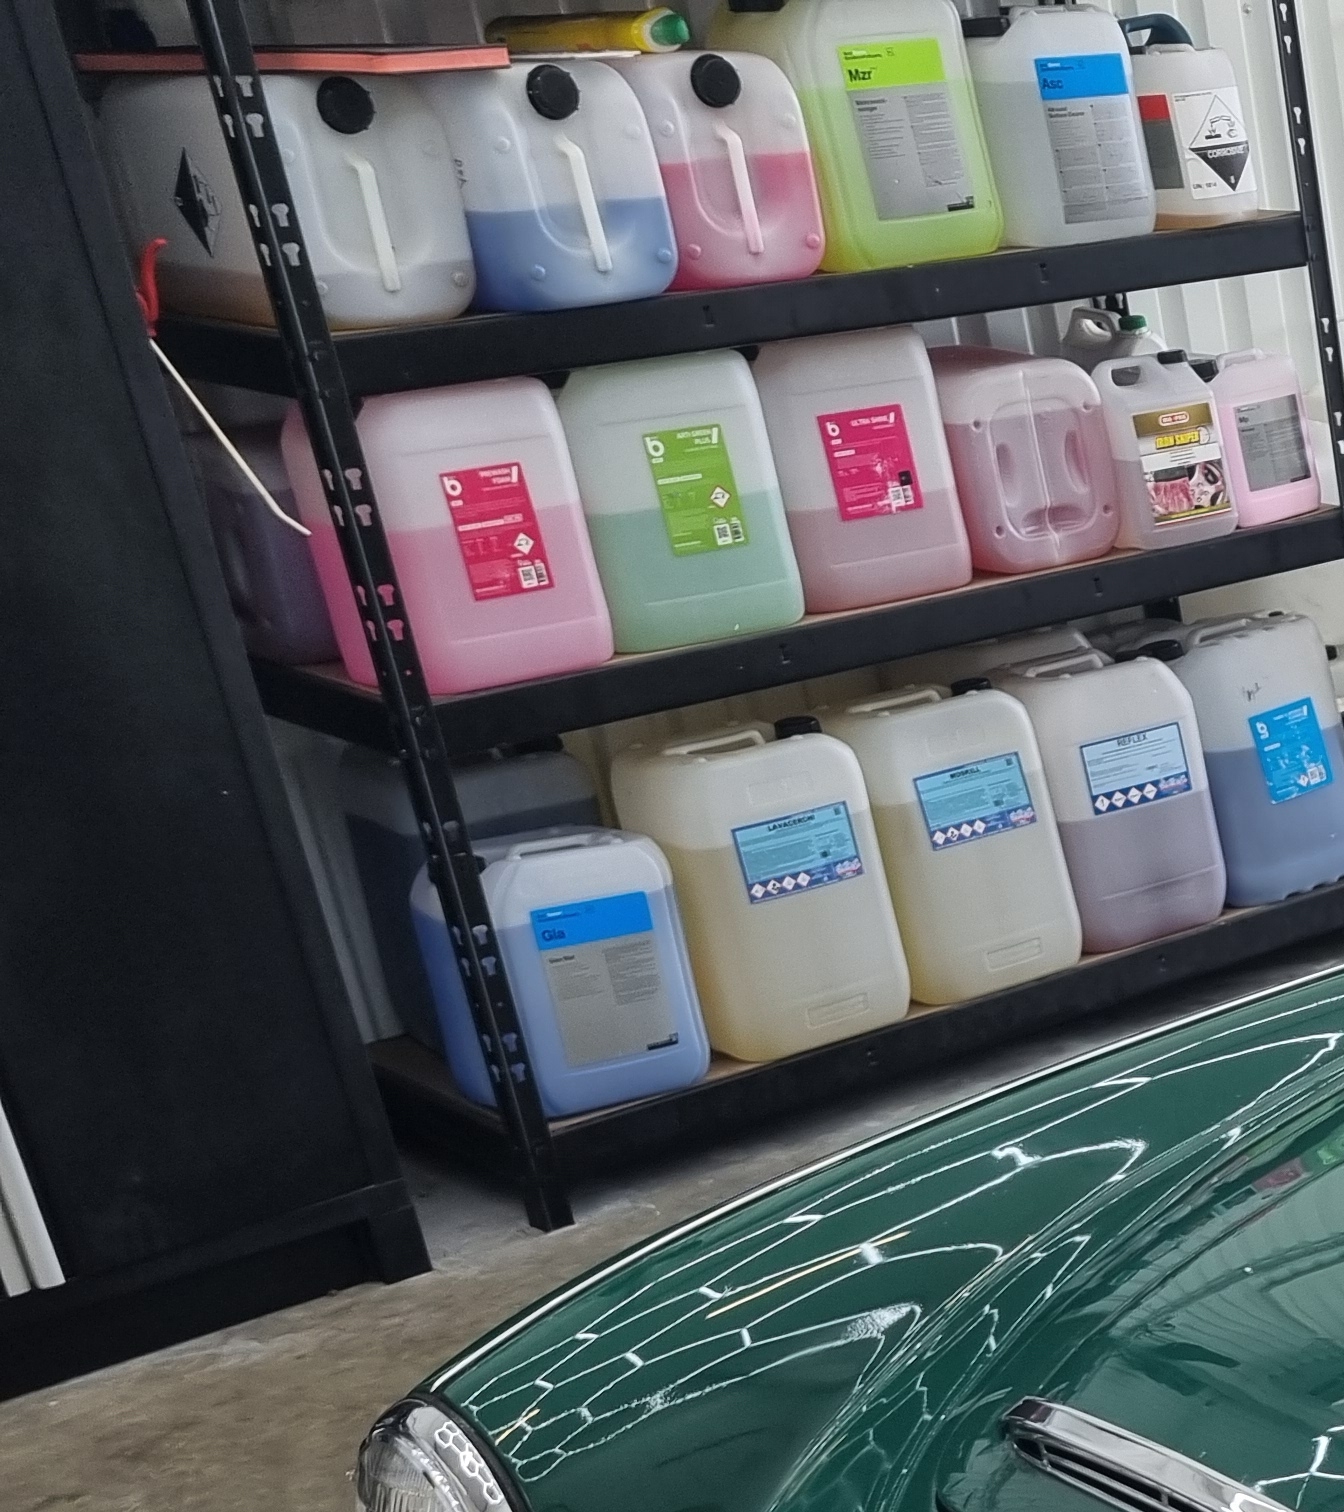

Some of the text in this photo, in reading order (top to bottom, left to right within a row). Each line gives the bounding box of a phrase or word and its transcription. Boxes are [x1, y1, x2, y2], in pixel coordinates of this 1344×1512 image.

[847, 69, 873, 82] Mzr
[1042, 77, 1064, 90] Asc
[1207, 144, 1247, 158] CORROSIVE
[1116, 733, 1149, 747] REFLEX
[541, 928, 566, 942] Gla
